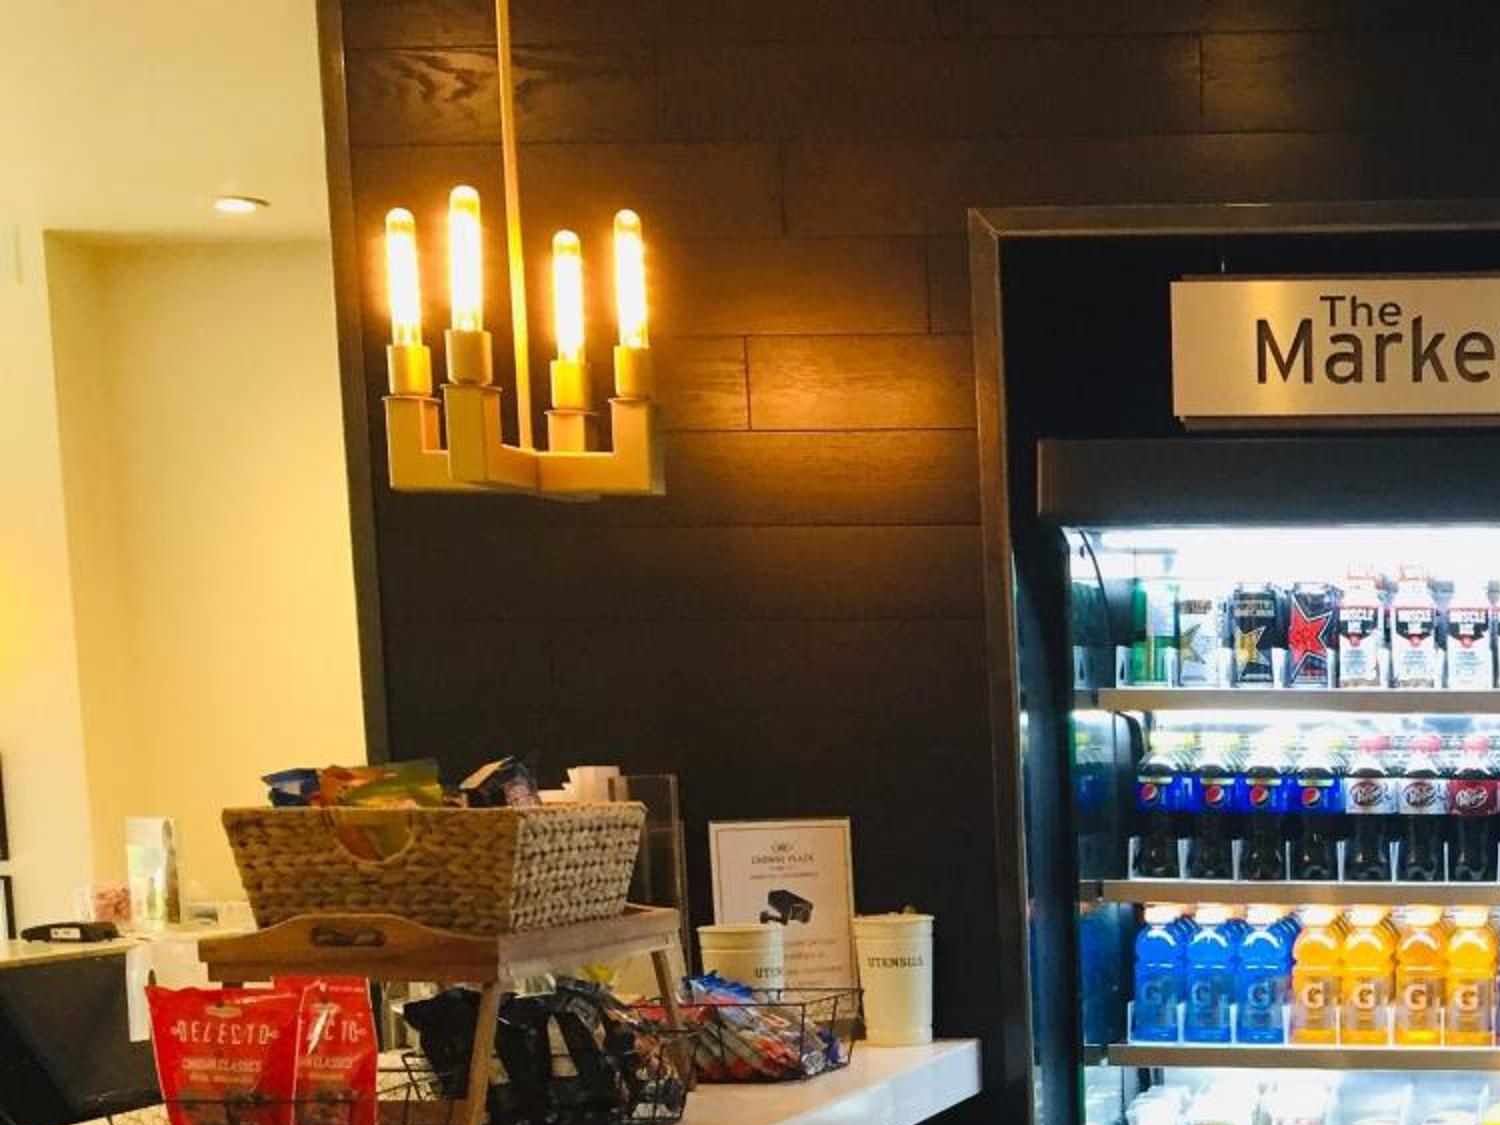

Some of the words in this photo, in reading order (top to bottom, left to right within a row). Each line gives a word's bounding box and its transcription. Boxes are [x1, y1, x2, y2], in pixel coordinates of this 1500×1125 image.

[1319, 295, 1402, 328] The
[1304, 982, 1325, 1009] G
[1353, 983, 1376, 1009] G
[1405, 984, 1427, 1010] G
[1456, 984, 1479, 1010] G
